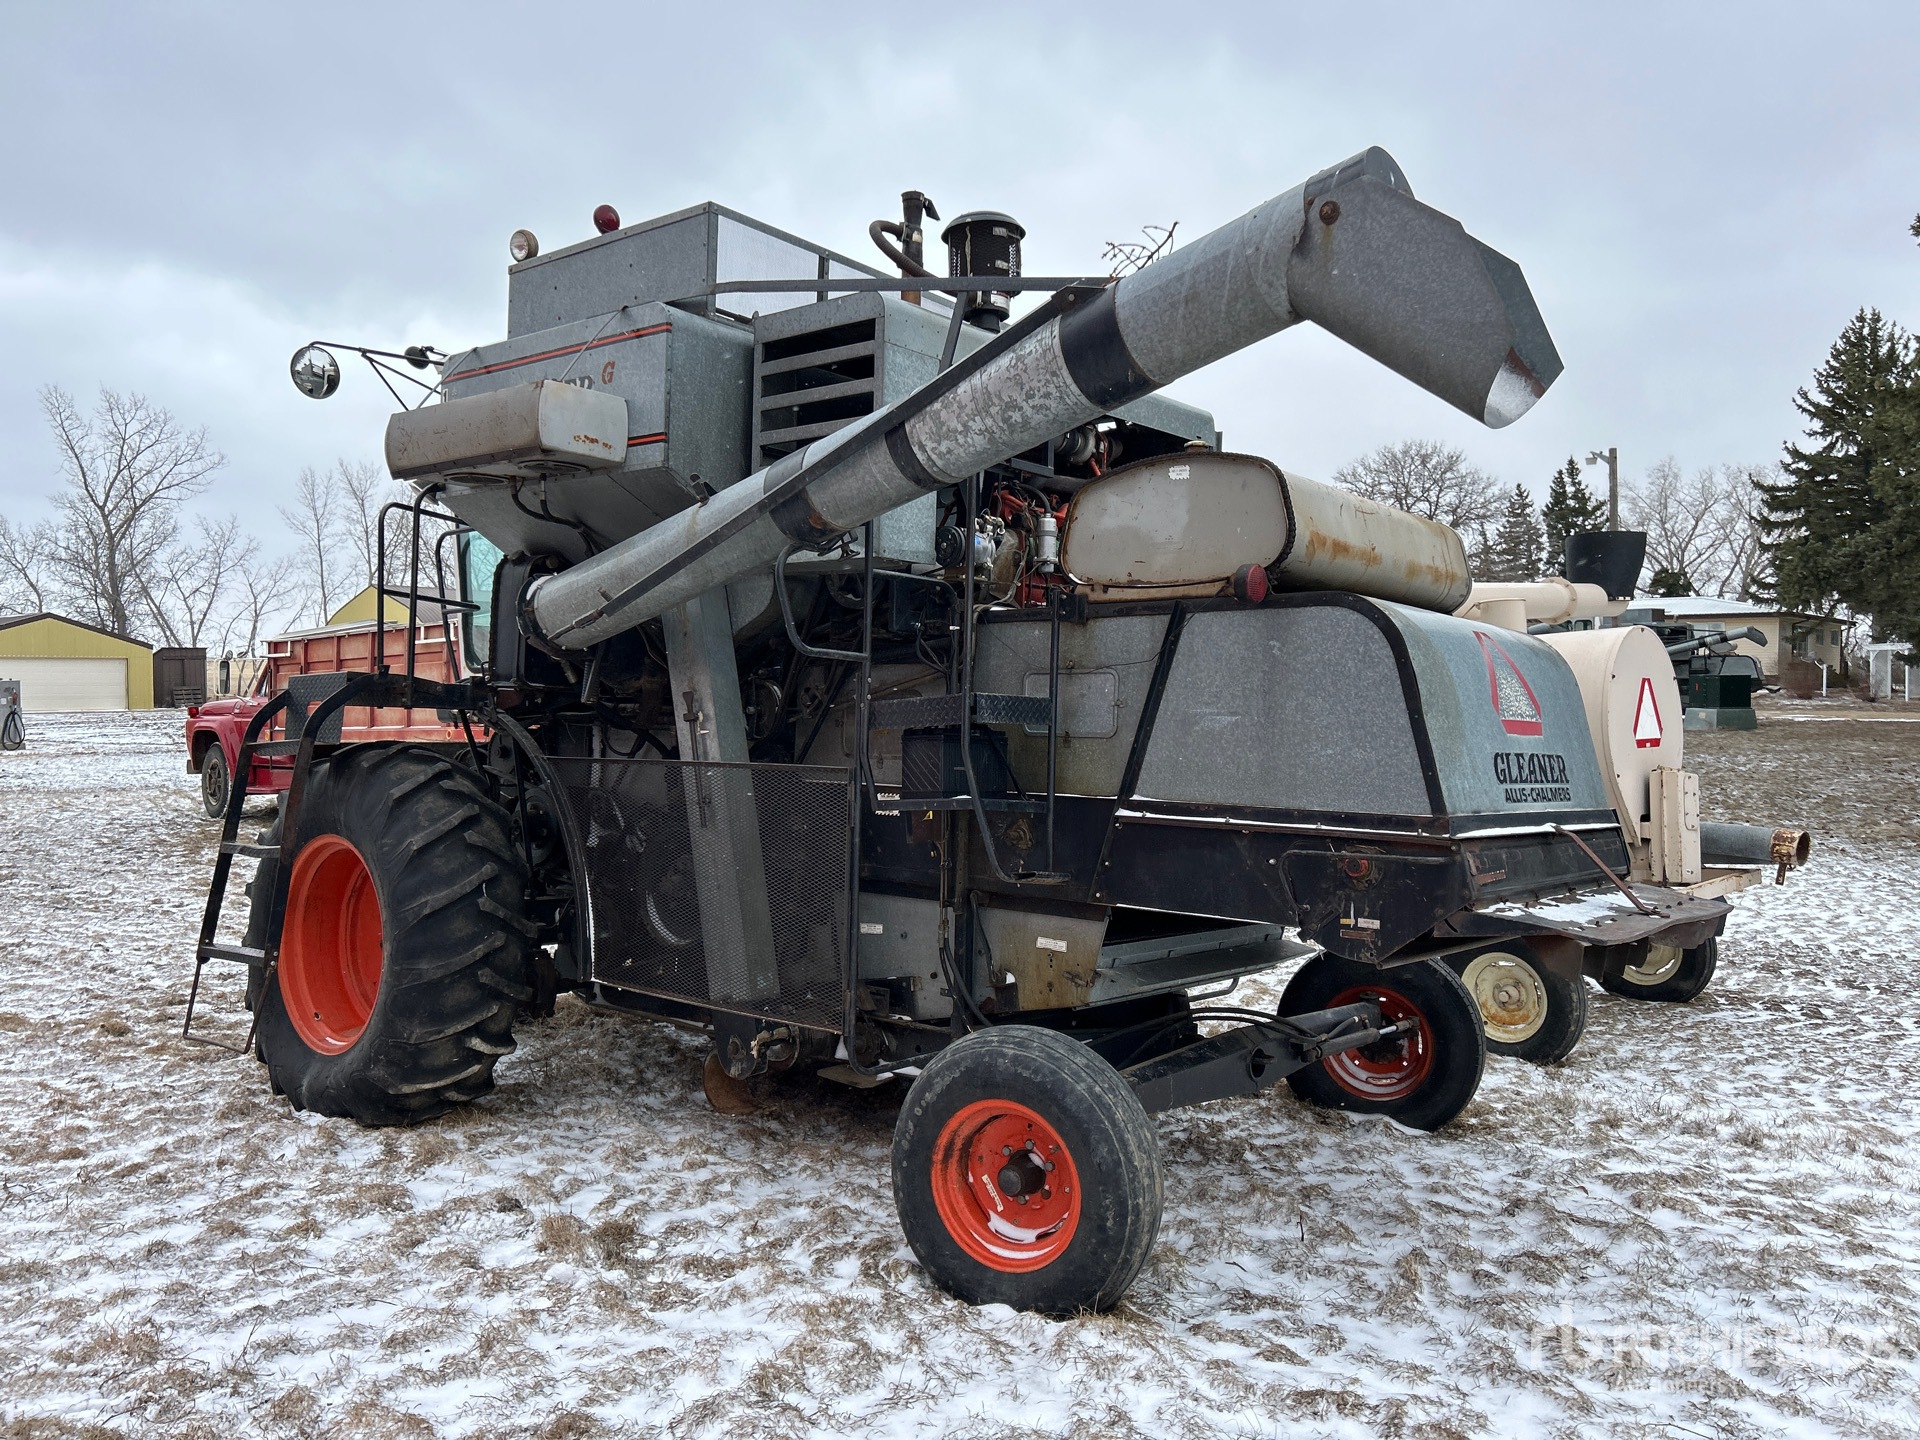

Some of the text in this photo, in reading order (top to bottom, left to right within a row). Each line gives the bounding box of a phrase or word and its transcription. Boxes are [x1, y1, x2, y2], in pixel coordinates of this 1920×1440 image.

[601, 360, 616, 385] G
[1494, 752, 1569, 784] GLEANER
[1505, 787, 1571, 803] ALLIS-CHALMERS
